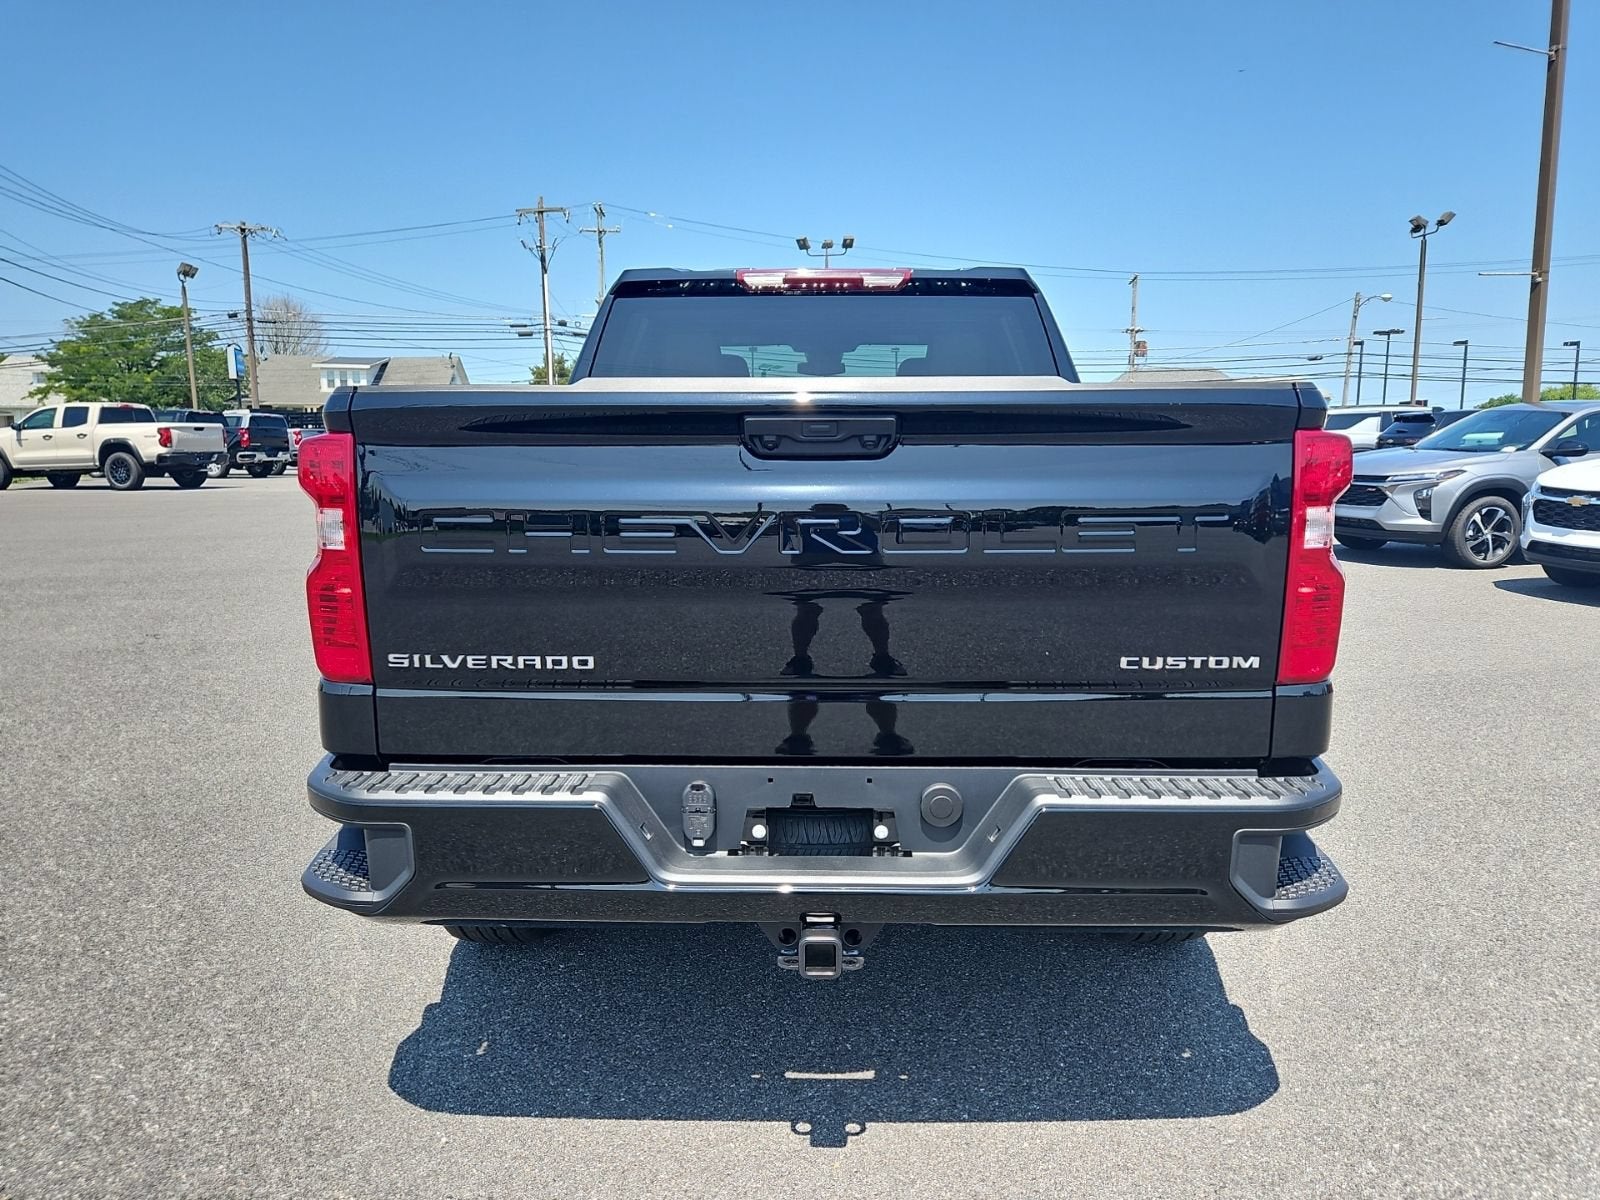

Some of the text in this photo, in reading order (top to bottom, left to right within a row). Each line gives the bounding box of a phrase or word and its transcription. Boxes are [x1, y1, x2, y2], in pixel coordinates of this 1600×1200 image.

[418, 509, 1230, 556] CHEVROLET
[387, 652, 595, 671] SILVERADO
[1119, 655, 1261, 671] CUSTOM
